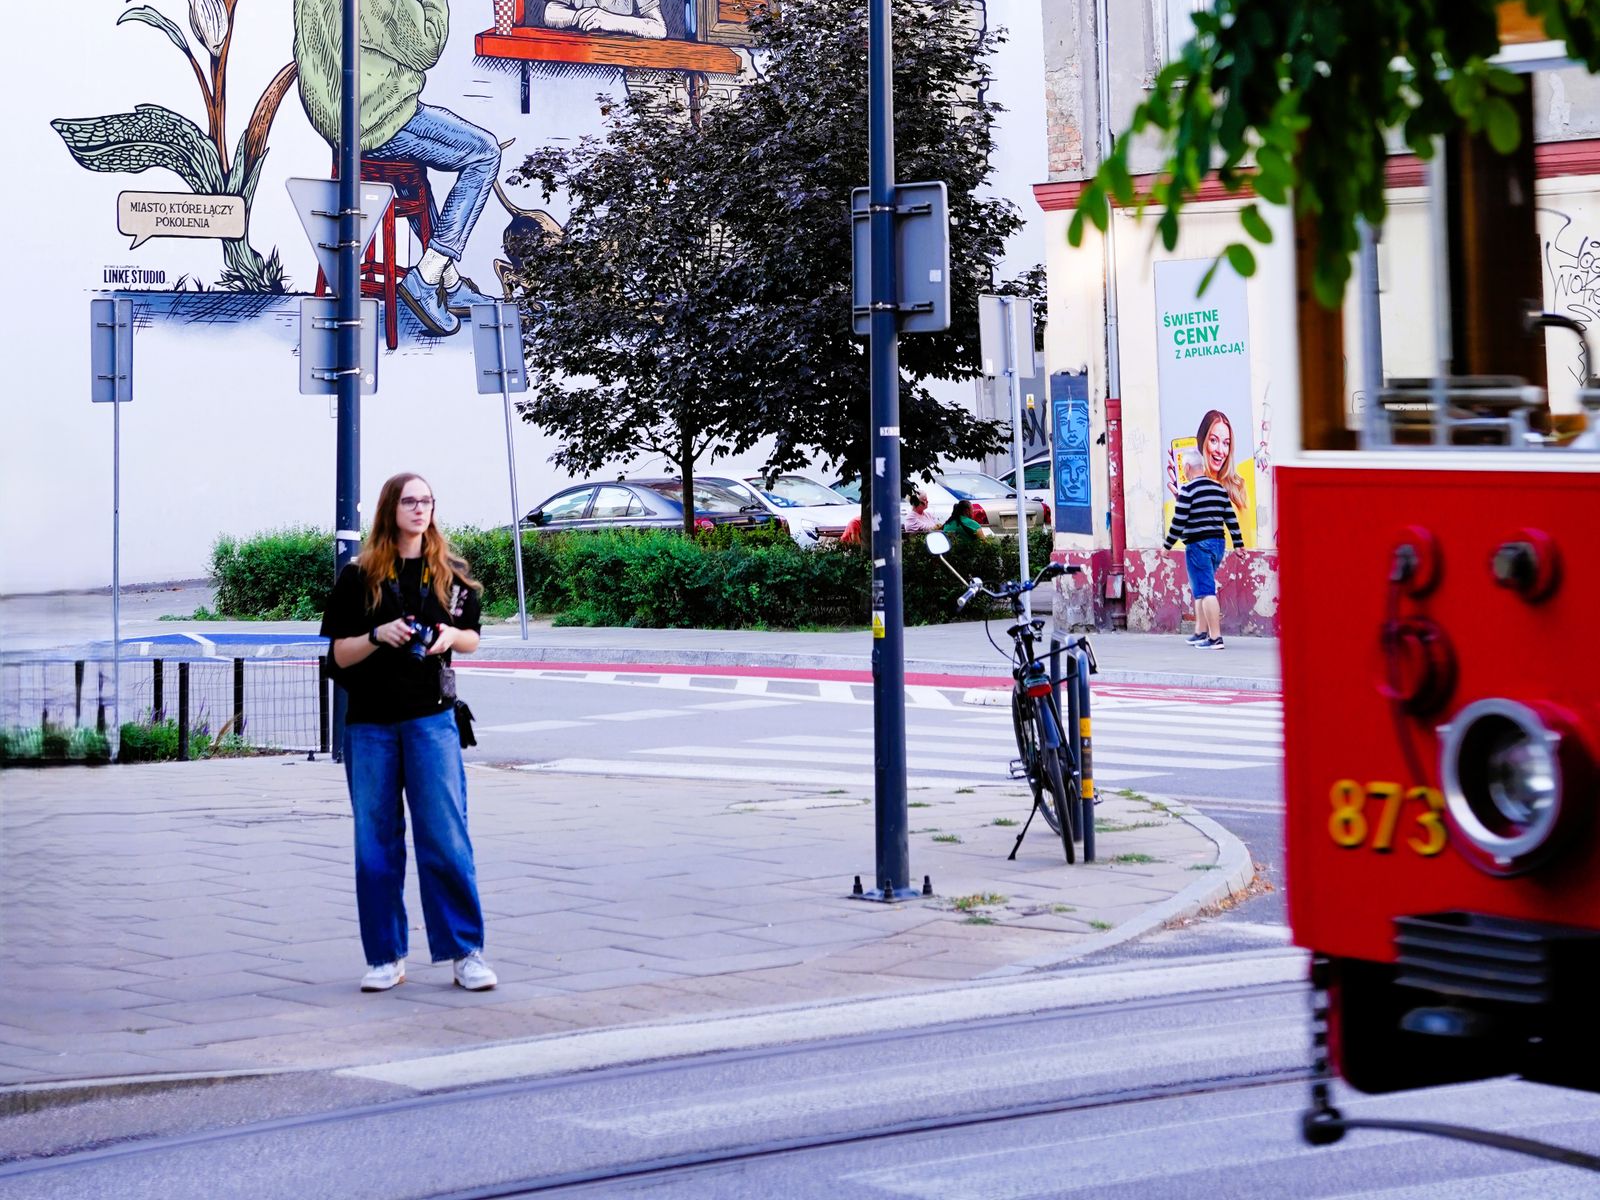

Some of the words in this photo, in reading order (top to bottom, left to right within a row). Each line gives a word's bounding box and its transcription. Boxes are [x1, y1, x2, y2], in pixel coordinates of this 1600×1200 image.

[130, 202, 169, 215] MIASTO,
[169, 201, 202, 214] KTÓRE
[203, 204, 234, 218] ŁĄCZY
[155, 216, 210, 228] POKOLENIA
[103, 269, 130, 283] LINKE
[131, 269, 166, 284] STUDIO
[1163, 309, 1219, 328] ŚWIETNE
[1173, 324, 1220, 346] CENY
[1175, 349, 1181, 359] Z
[1184, 341, 1245, 359] APLIKACJĄ!
[1328, 779, 1448, 857] 873
